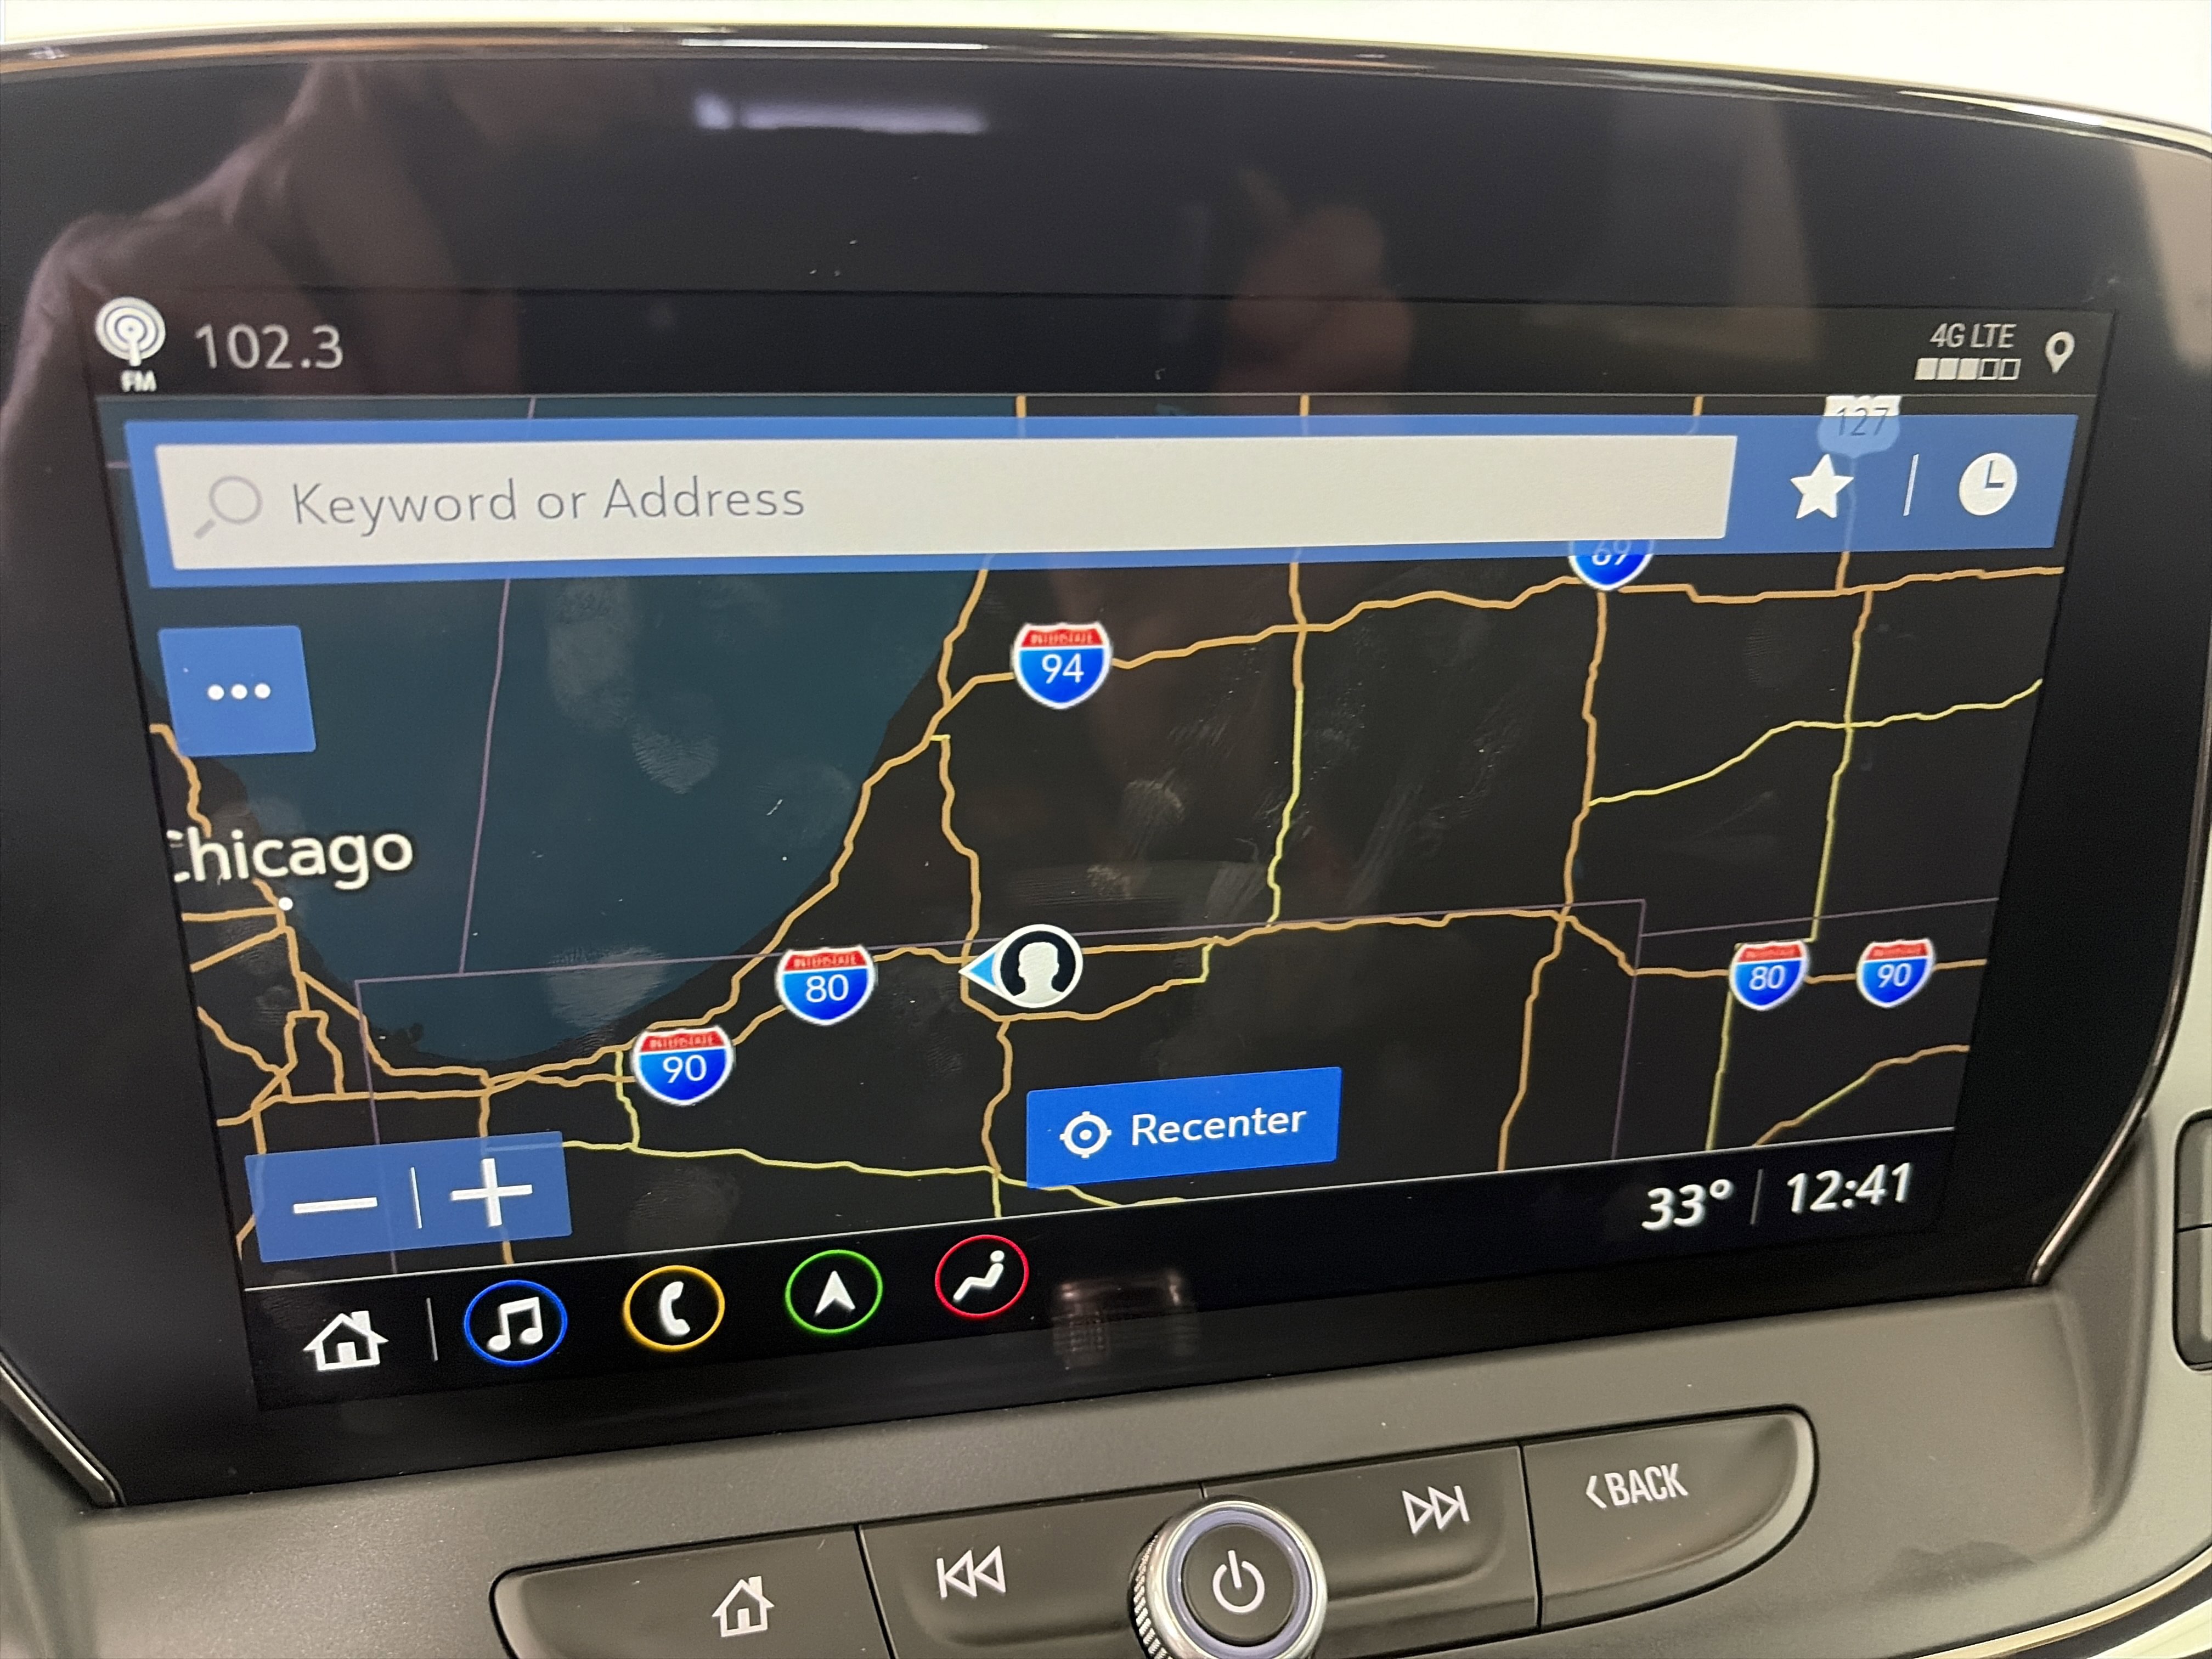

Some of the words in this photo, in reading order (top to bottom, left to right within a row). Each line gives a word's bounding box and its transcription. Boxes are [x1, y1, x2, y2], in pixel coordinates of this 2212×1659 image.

[194, 323, 343, 370] 102.3
[1929, 323, 1965, 348] 4G
[1970, 323, 2017, 348] LTE
[120, 370, 157, 392] FM
[1837, 407, 1891, 436] 127
[292, 478, 517, 538] Keyword
[537, 489, 587, 520] or
[603, 475, 805, 518] Address
[1041, 652, 1085, 684] 94
[805, 974, 849, 1003] 80
[1748, 964, 1786, 991] 80
[1877, 963, 1912, 988] 90
[663, 1054, 707, 1084] 90
[1132, 1107, 1307, 1146] Recenter
[1641, 1178, 1734, 1231] 33°
[1787, 1162, 1912, 1214] 12:41
